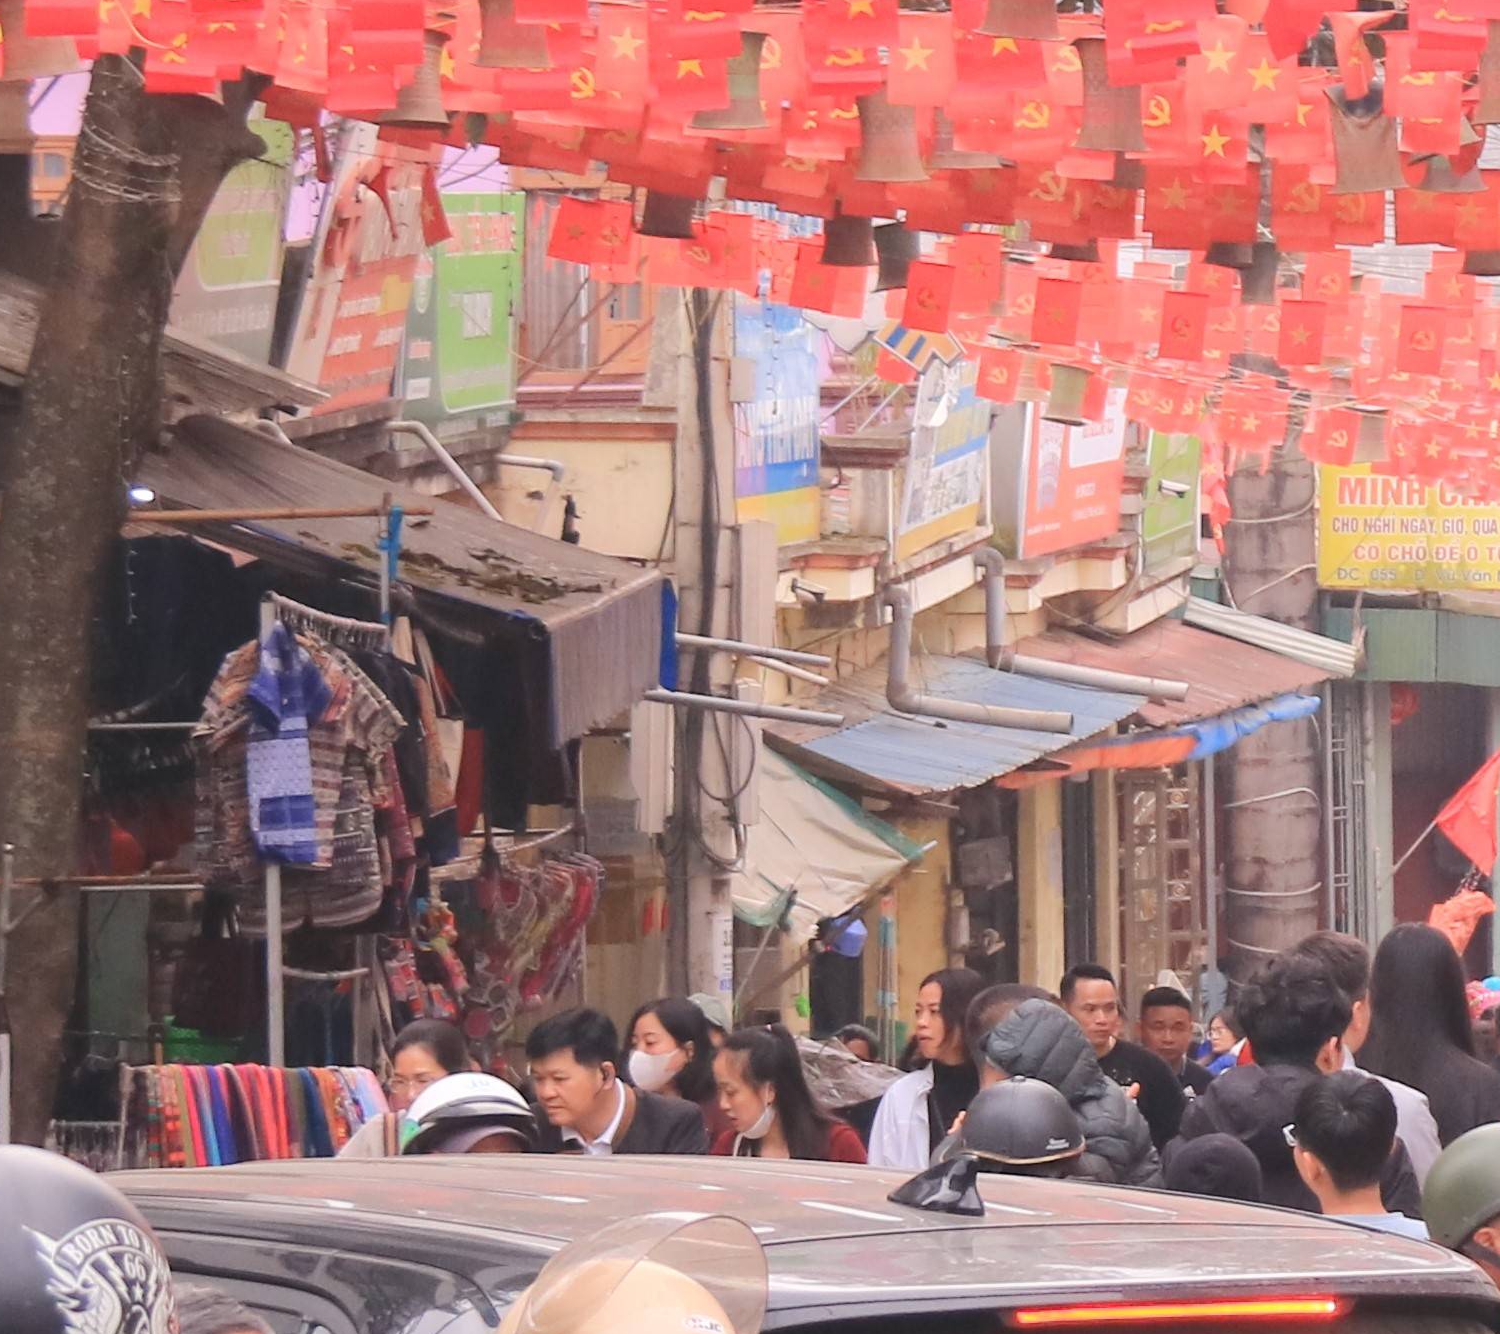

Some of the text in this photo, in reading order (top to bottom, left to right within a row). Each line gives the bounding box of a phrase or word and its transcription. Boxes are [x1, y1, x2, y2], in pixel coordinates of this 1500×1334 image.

[1336, 475, 1427, 507] MINH
[1331, 517, 1359, 535] CHO
[1472, 517, 1499, 536] QUA
[60, 1223, 118, 1265] BORN
[116, 1224, 141, 1249] TO
[123, 1252, 147, 1282] 66
